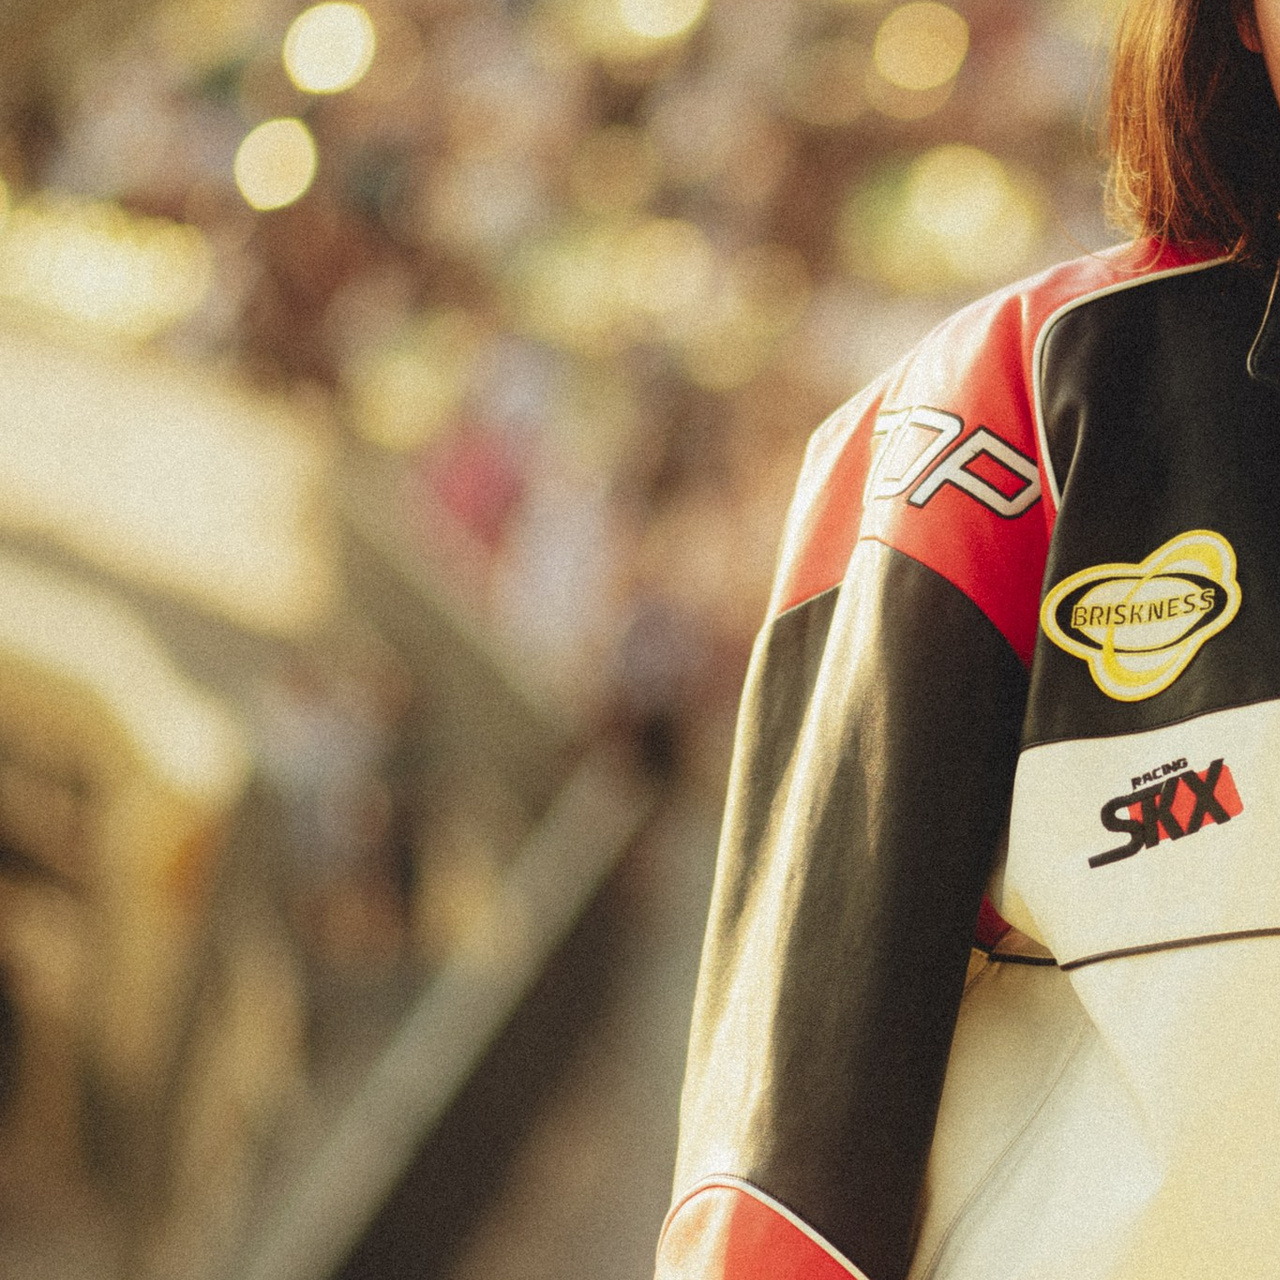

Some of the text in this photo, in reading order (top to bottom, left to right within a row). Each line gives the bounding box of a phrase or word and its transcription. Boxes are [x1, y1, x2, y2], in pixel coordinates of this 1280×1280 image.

[1072, 588, 1215, 628] BRISKNESS
[1131, 757, 1188, 791] RACING
[1088, 758, 1231, 869] SKX
